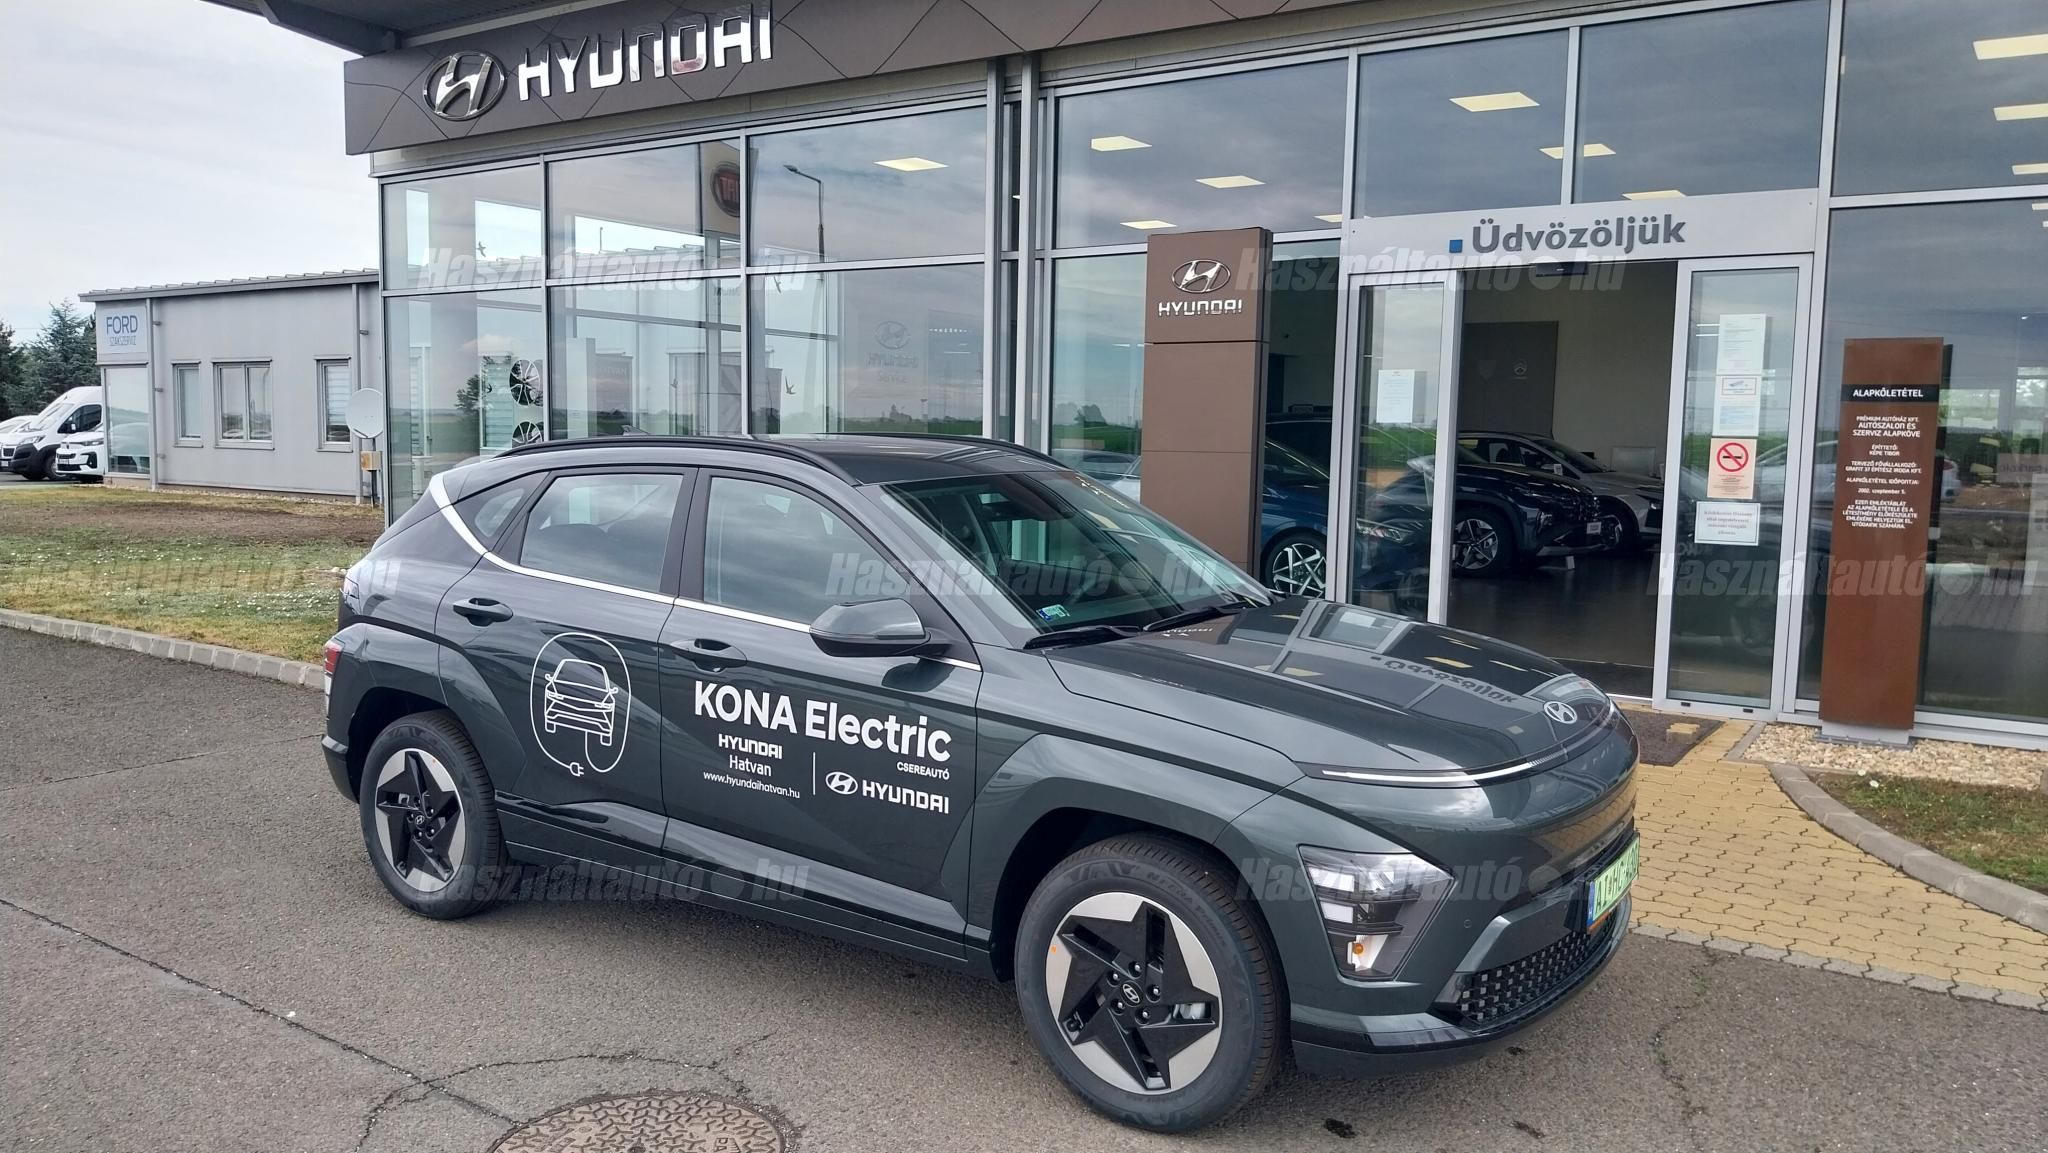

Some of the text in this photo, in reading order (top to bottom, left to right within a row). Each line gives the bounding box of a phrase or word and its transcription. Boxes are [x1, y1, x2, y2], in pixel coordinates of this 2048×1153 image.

[518, 2, 773, 101] HYUNDAI
[1472, 213, 1687, 254] Üdvözöljük
[1158, 299, 1242, 317] HYUNDAI
[106, 315, 138, 335] FORD
[1853, 387, 1924, 398] ALAPKŐLETÉTEL
[1907, 422, 1916, 430] ÉS
[694, 680, 952, 762] KONA Electric
[718, 733, 783, 760] HYUNDAI
[729, 755, 772, 777] Hatvan
[896, 761, 950, 780] CSEREAUTÓ
[703, 771, 800, 799] www.hyundaihatvan.hu
[862, 779, 949, 814] HYUNDAI
